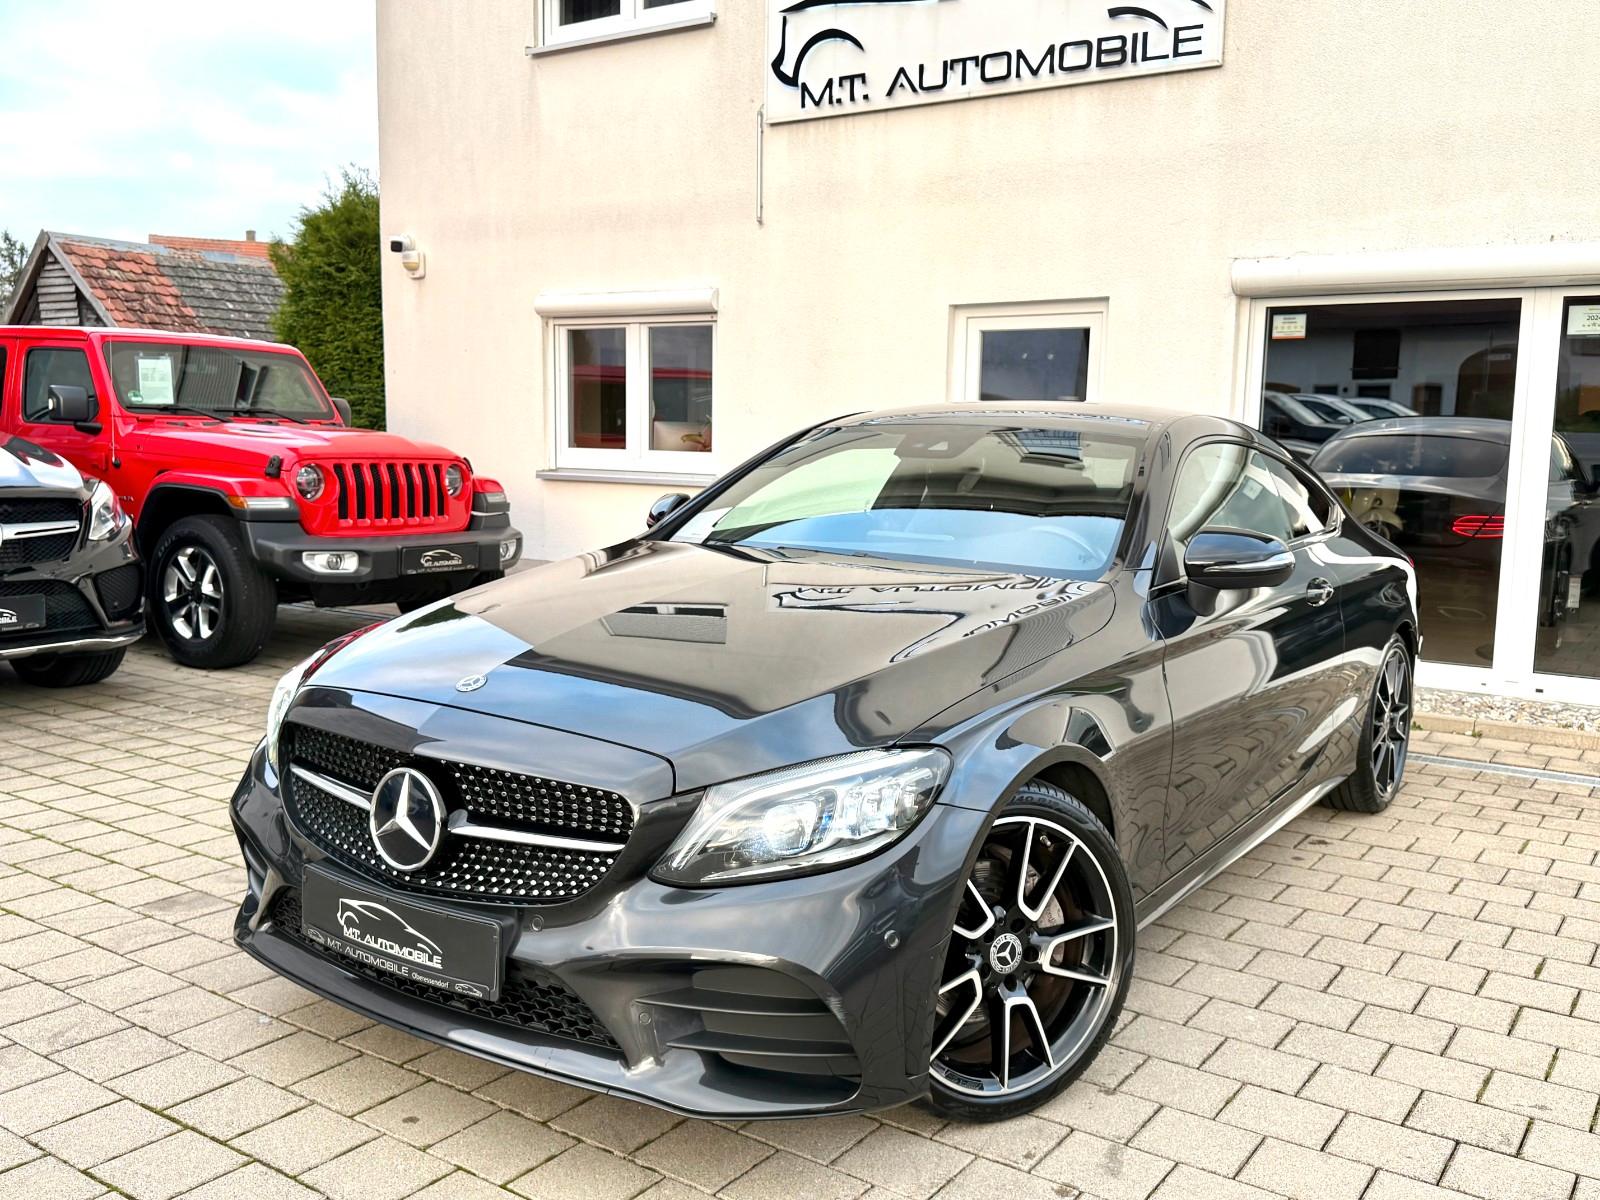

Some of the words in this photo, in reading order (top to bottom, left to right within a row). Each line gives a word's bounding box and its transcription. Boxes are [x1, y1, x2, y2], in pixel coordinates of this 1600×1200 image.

[800, 73, 870, 109] M.T.
[886, 23, 1205, 97] AUTOMOBILE
[327, 937, 342, 951] M.T.
[345, 946, 409, 976] AUTOMOBILE
[364, 933, 443, 968] AUTOMOBILE
